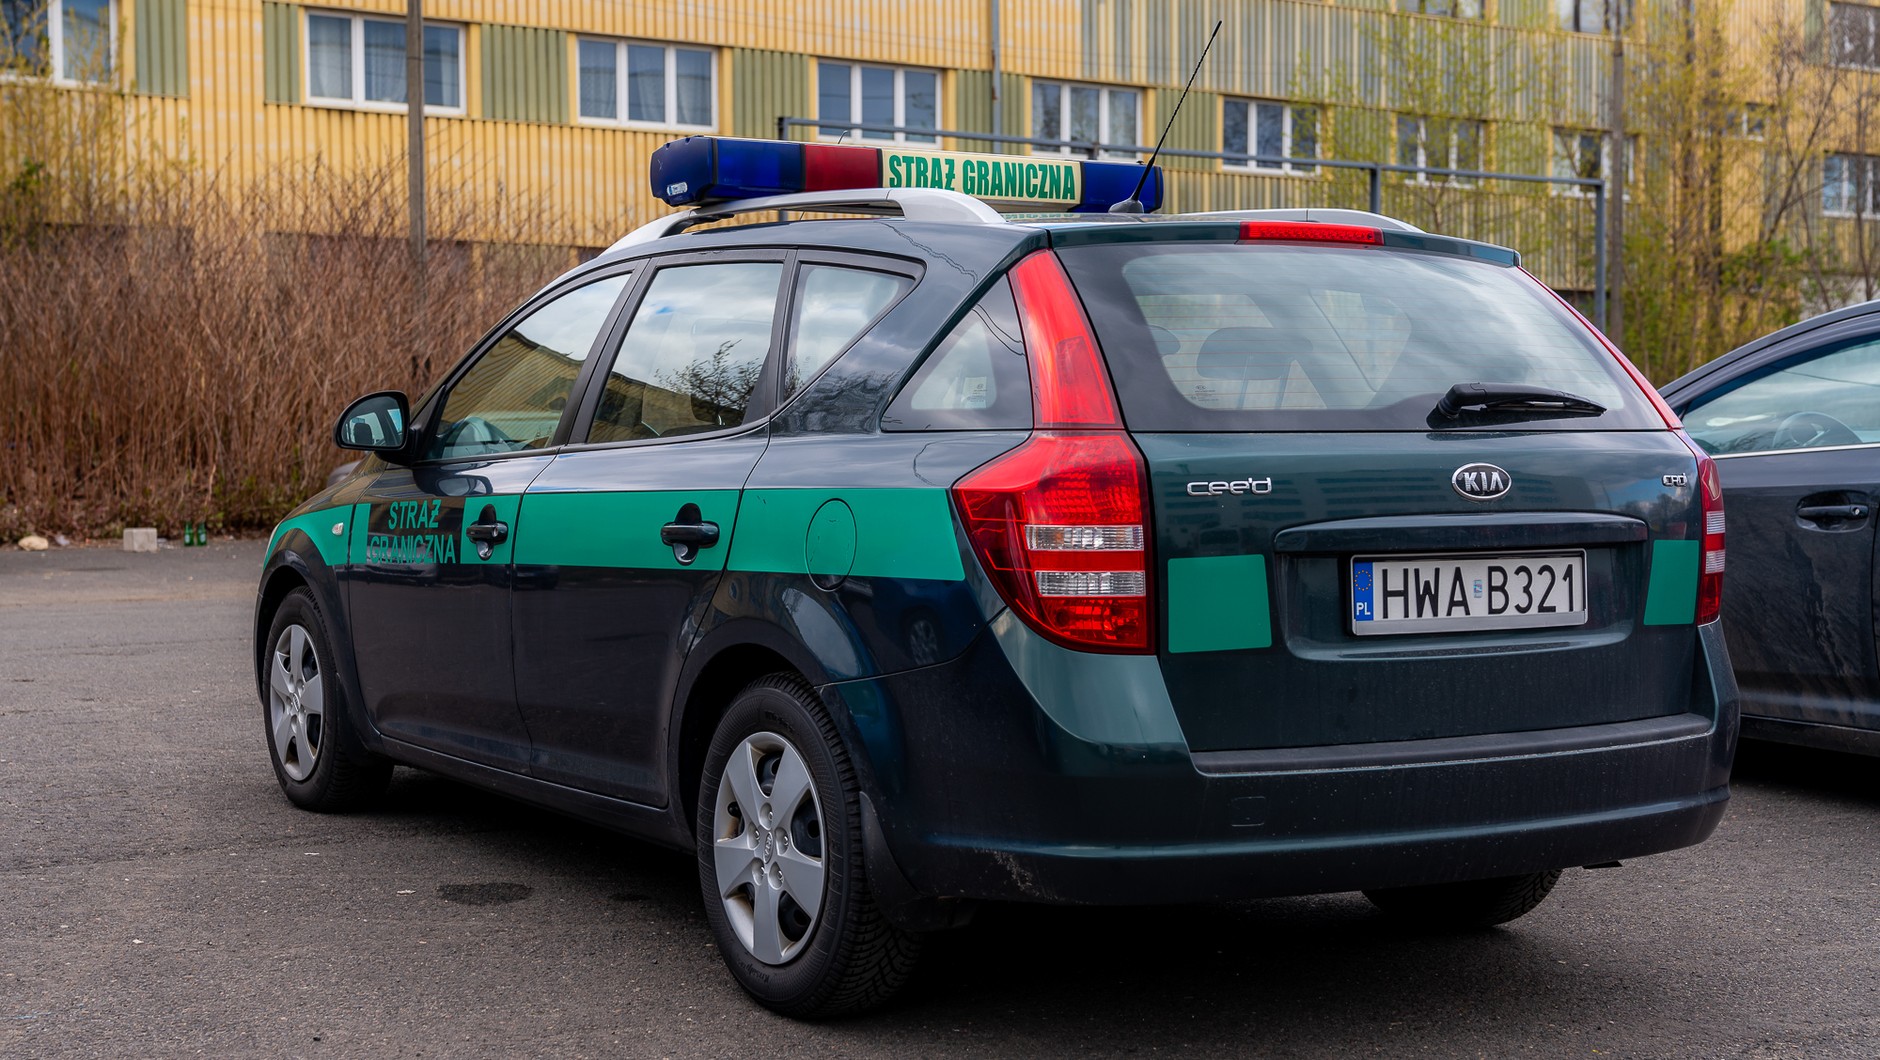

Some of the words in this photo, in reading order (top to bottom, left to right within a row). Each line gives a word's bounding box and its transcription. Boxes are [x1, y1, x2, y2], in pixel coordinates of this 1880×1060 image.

[962, 160, 1076, 200] GRANICZNA
[1187, 477, 1272, 496] cee'd
[1462, 471, 1505, 491] KIA
[369, 534, 456, 564] GRANICZNA
[1381, 566, 1471, 619] HWA
[1487, 563, 1574, 615] B321
[1356, 602, 1371, 616] PL
